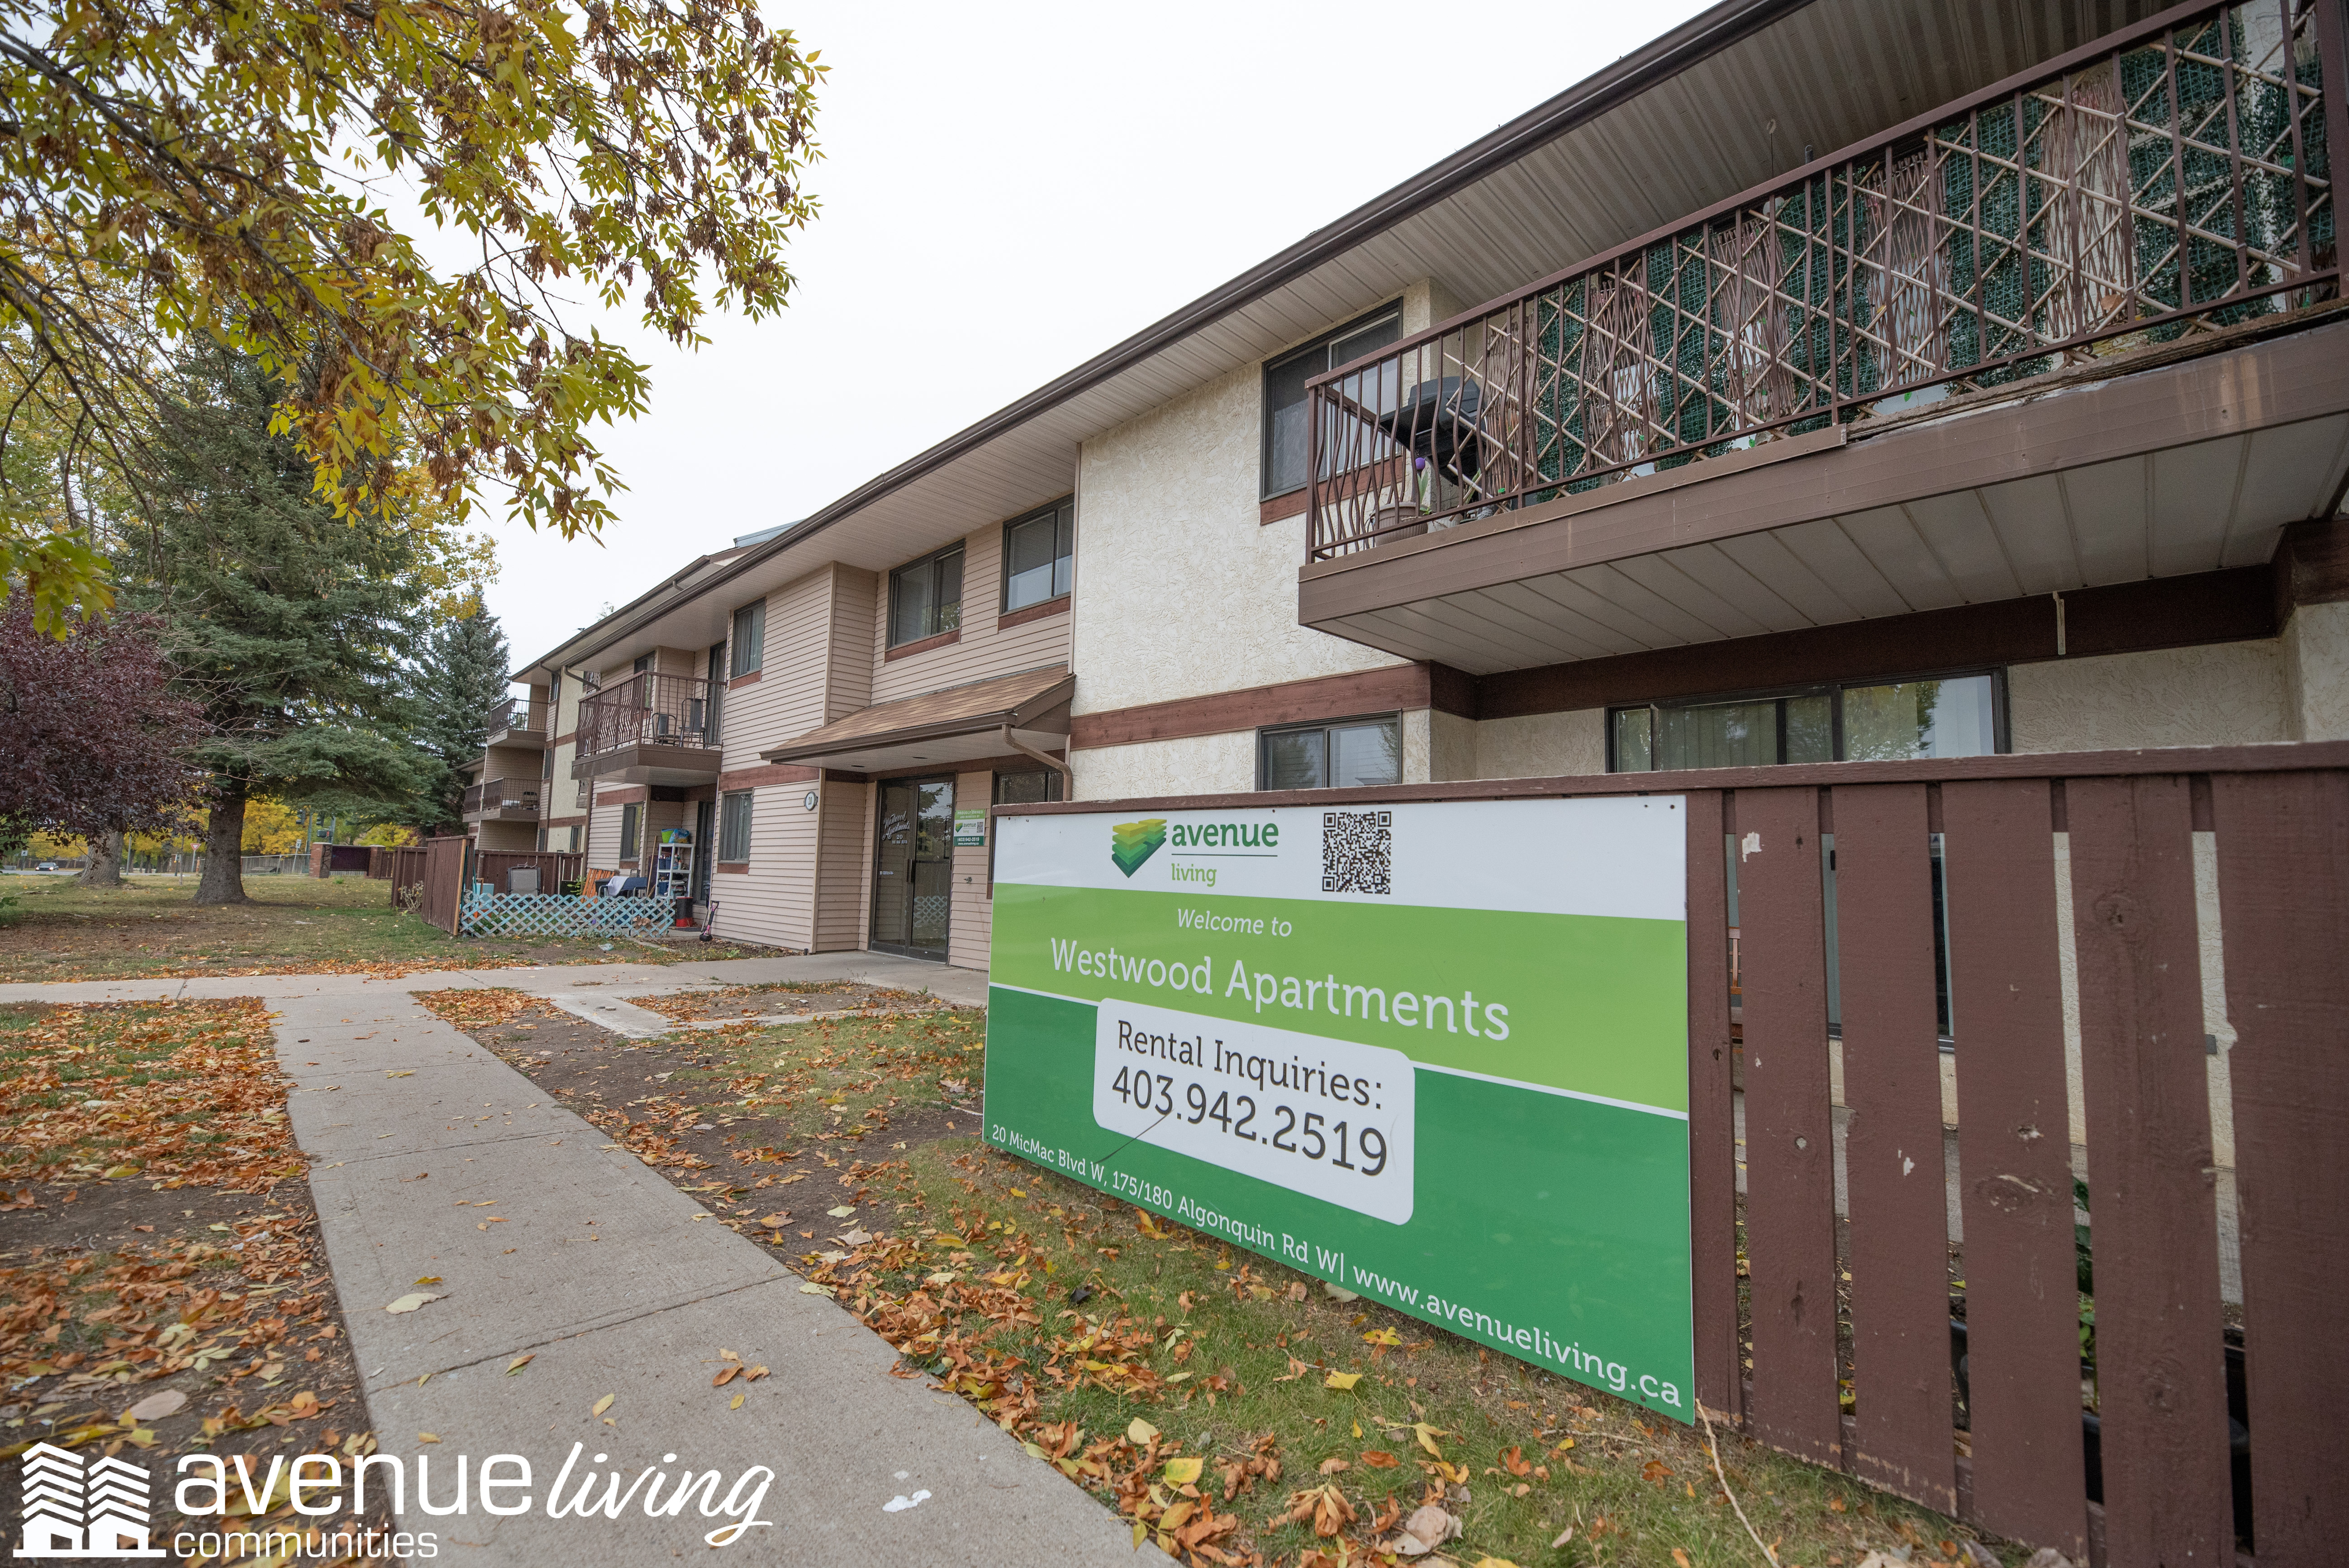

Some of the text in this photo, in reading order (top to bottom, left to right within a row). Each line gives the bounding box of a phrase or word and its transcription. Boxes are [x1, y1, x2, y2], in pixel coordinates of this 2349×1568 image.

[808, 797, 812, 805] 20
[882, 821, 910, 840] Apartments
[1171, 823, 1279, 847] avenue
[1171, 863, 1217, 887] living
[1177, 908, 1292, 937] Welcome to
[1051, 937, 1510, 1041] Westwood Apartments
[1118, 1020, 1381, 1110] Rental Inquiries:
[1112, 1066, 1387, 1177] 403.942.2519
[992, 1124, 1006, 1143] 20
[1009, 1131, 1054, 1163] MicMac
[1059, 1149, 1086, 1176] Blvd
[1090, 1161, 1107, 1187] W,
[1112, 1171, 1172, 1209] 175/180
[1178, 1196, 1275, 1250] Algonquin
[1282, 1233, 1308, 1264] Rd
[1353, 1266, 1682, 1408] www.avenueliving.ca
